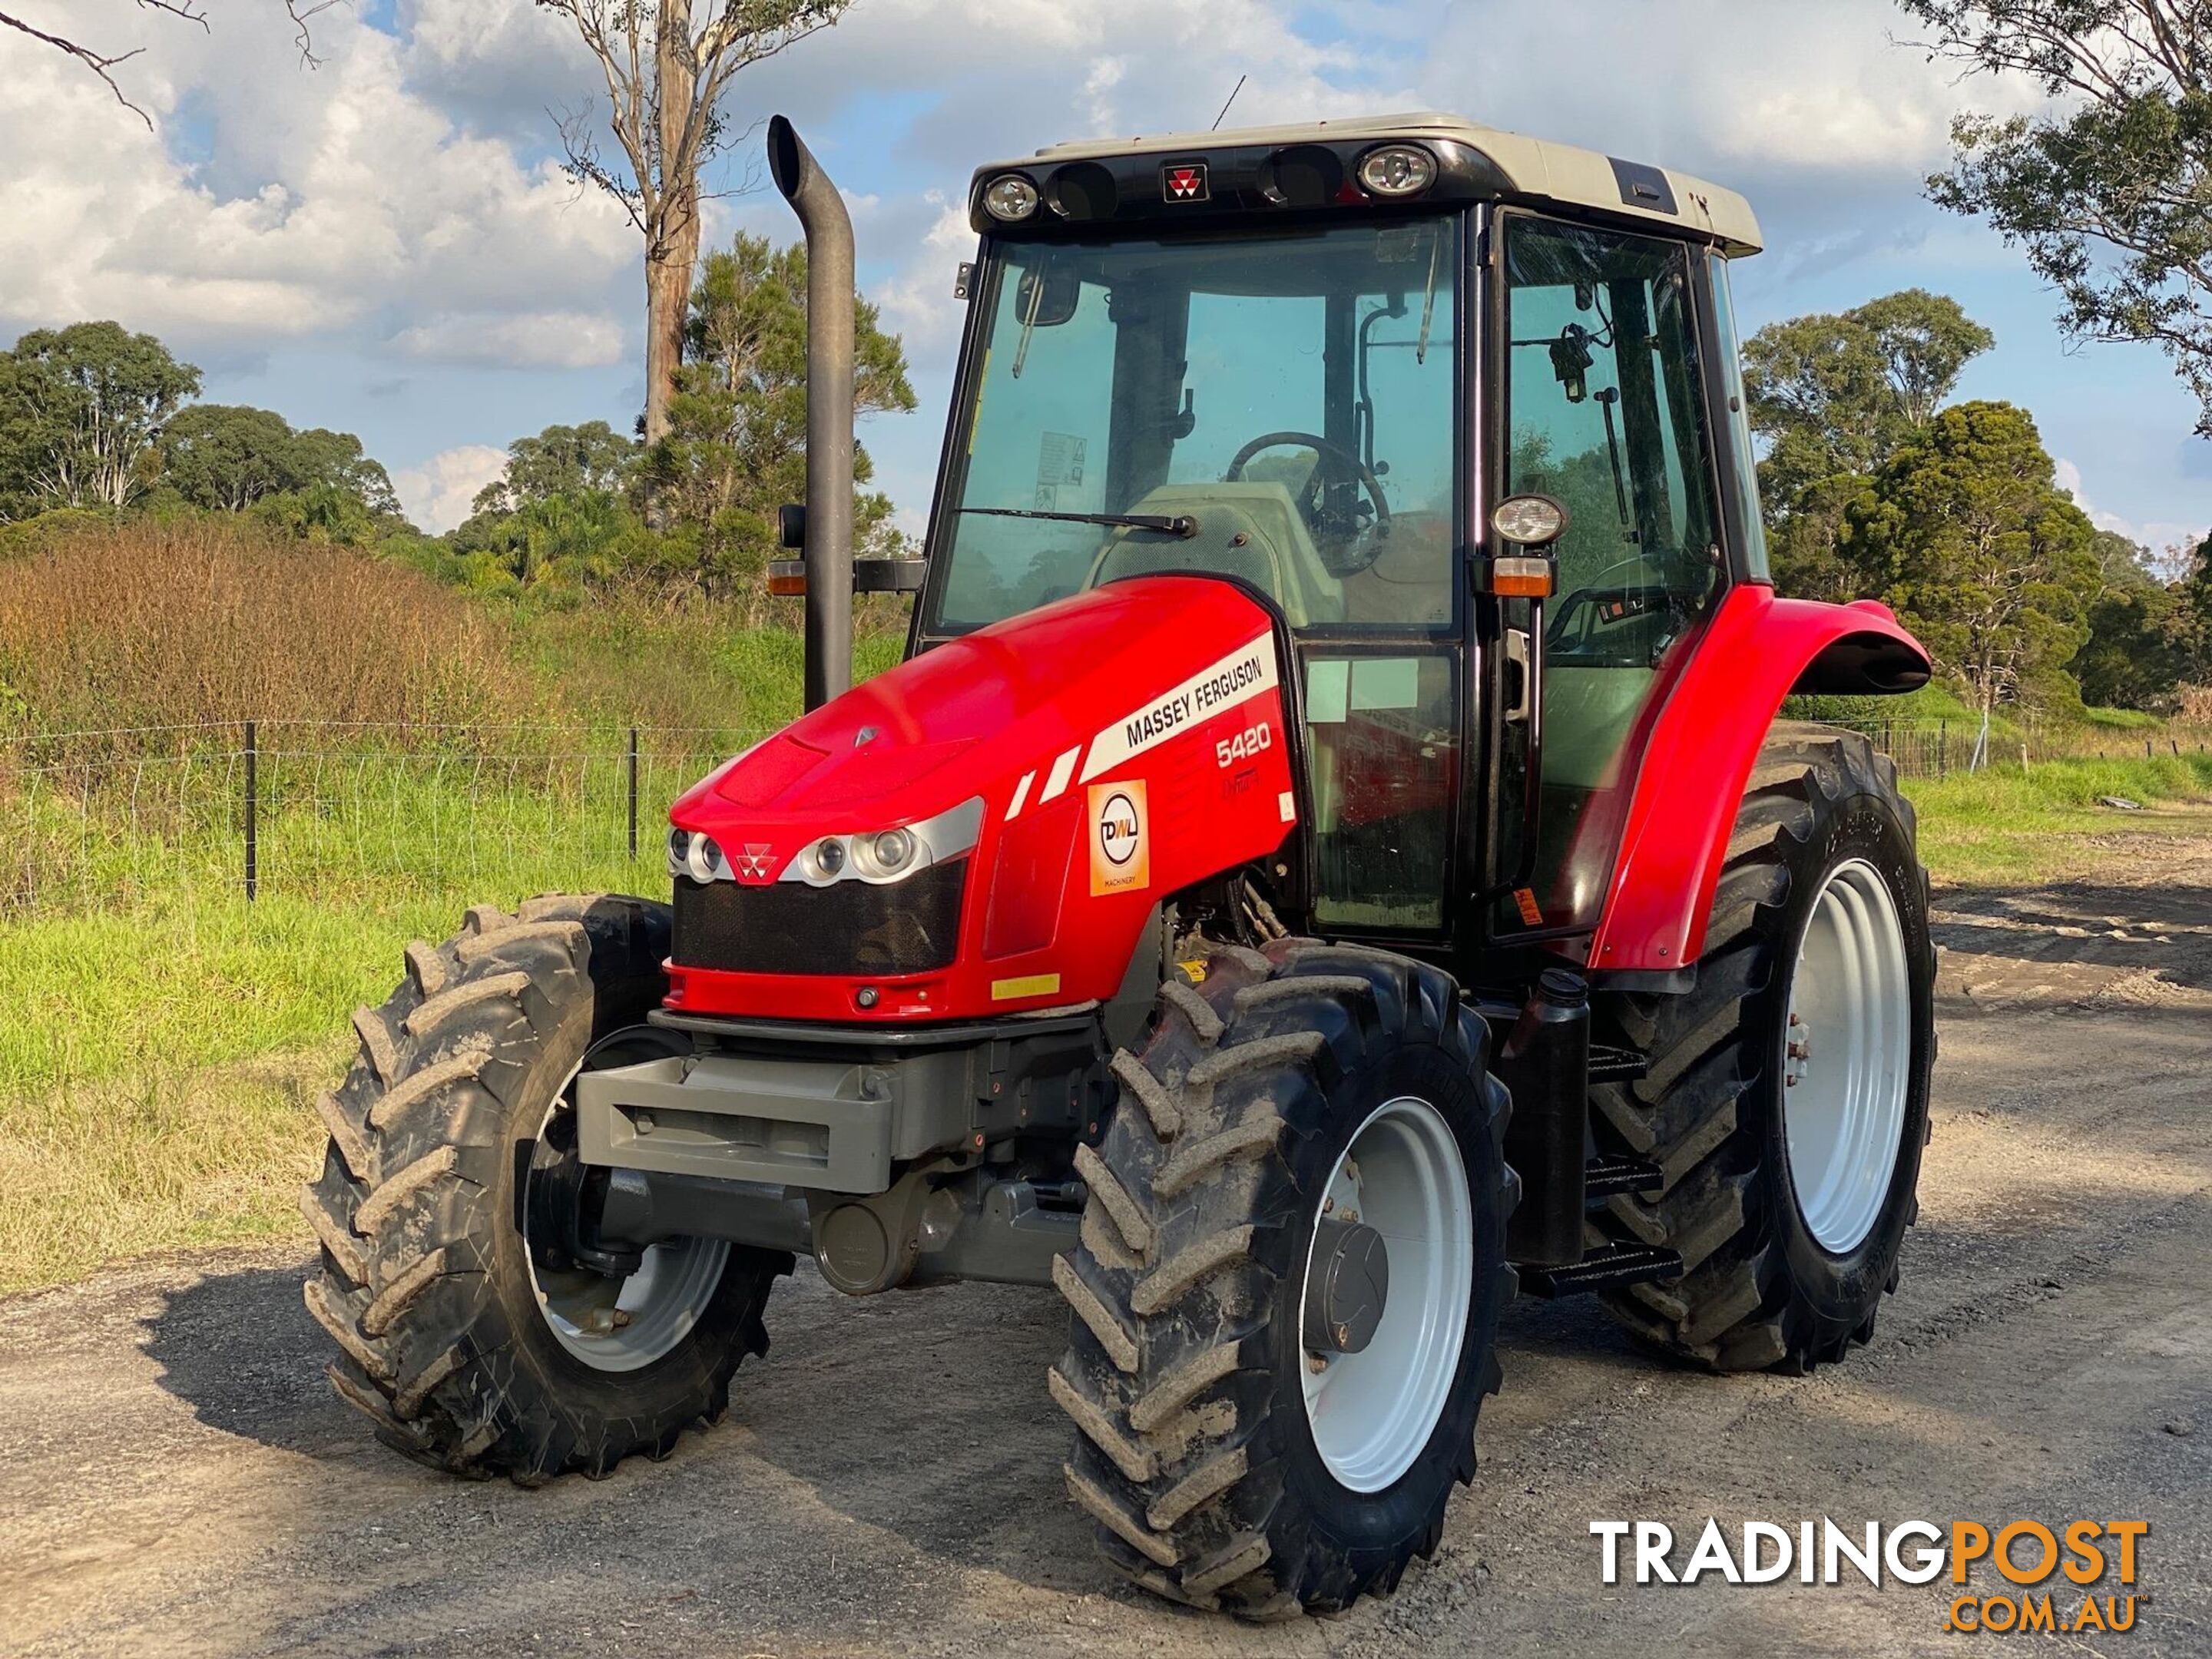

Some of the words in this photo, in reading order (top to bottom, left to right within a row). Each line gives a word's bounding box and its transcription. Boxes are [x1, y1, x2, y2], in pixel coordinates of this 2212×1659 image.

[1126, 693, 1190, 747] MASSEY
[1194, 656, 1262, 711] FERGUSON
[1216, 722, 1271, 768] 5420
[1104, 876, 1136, 887] MACHINERY
